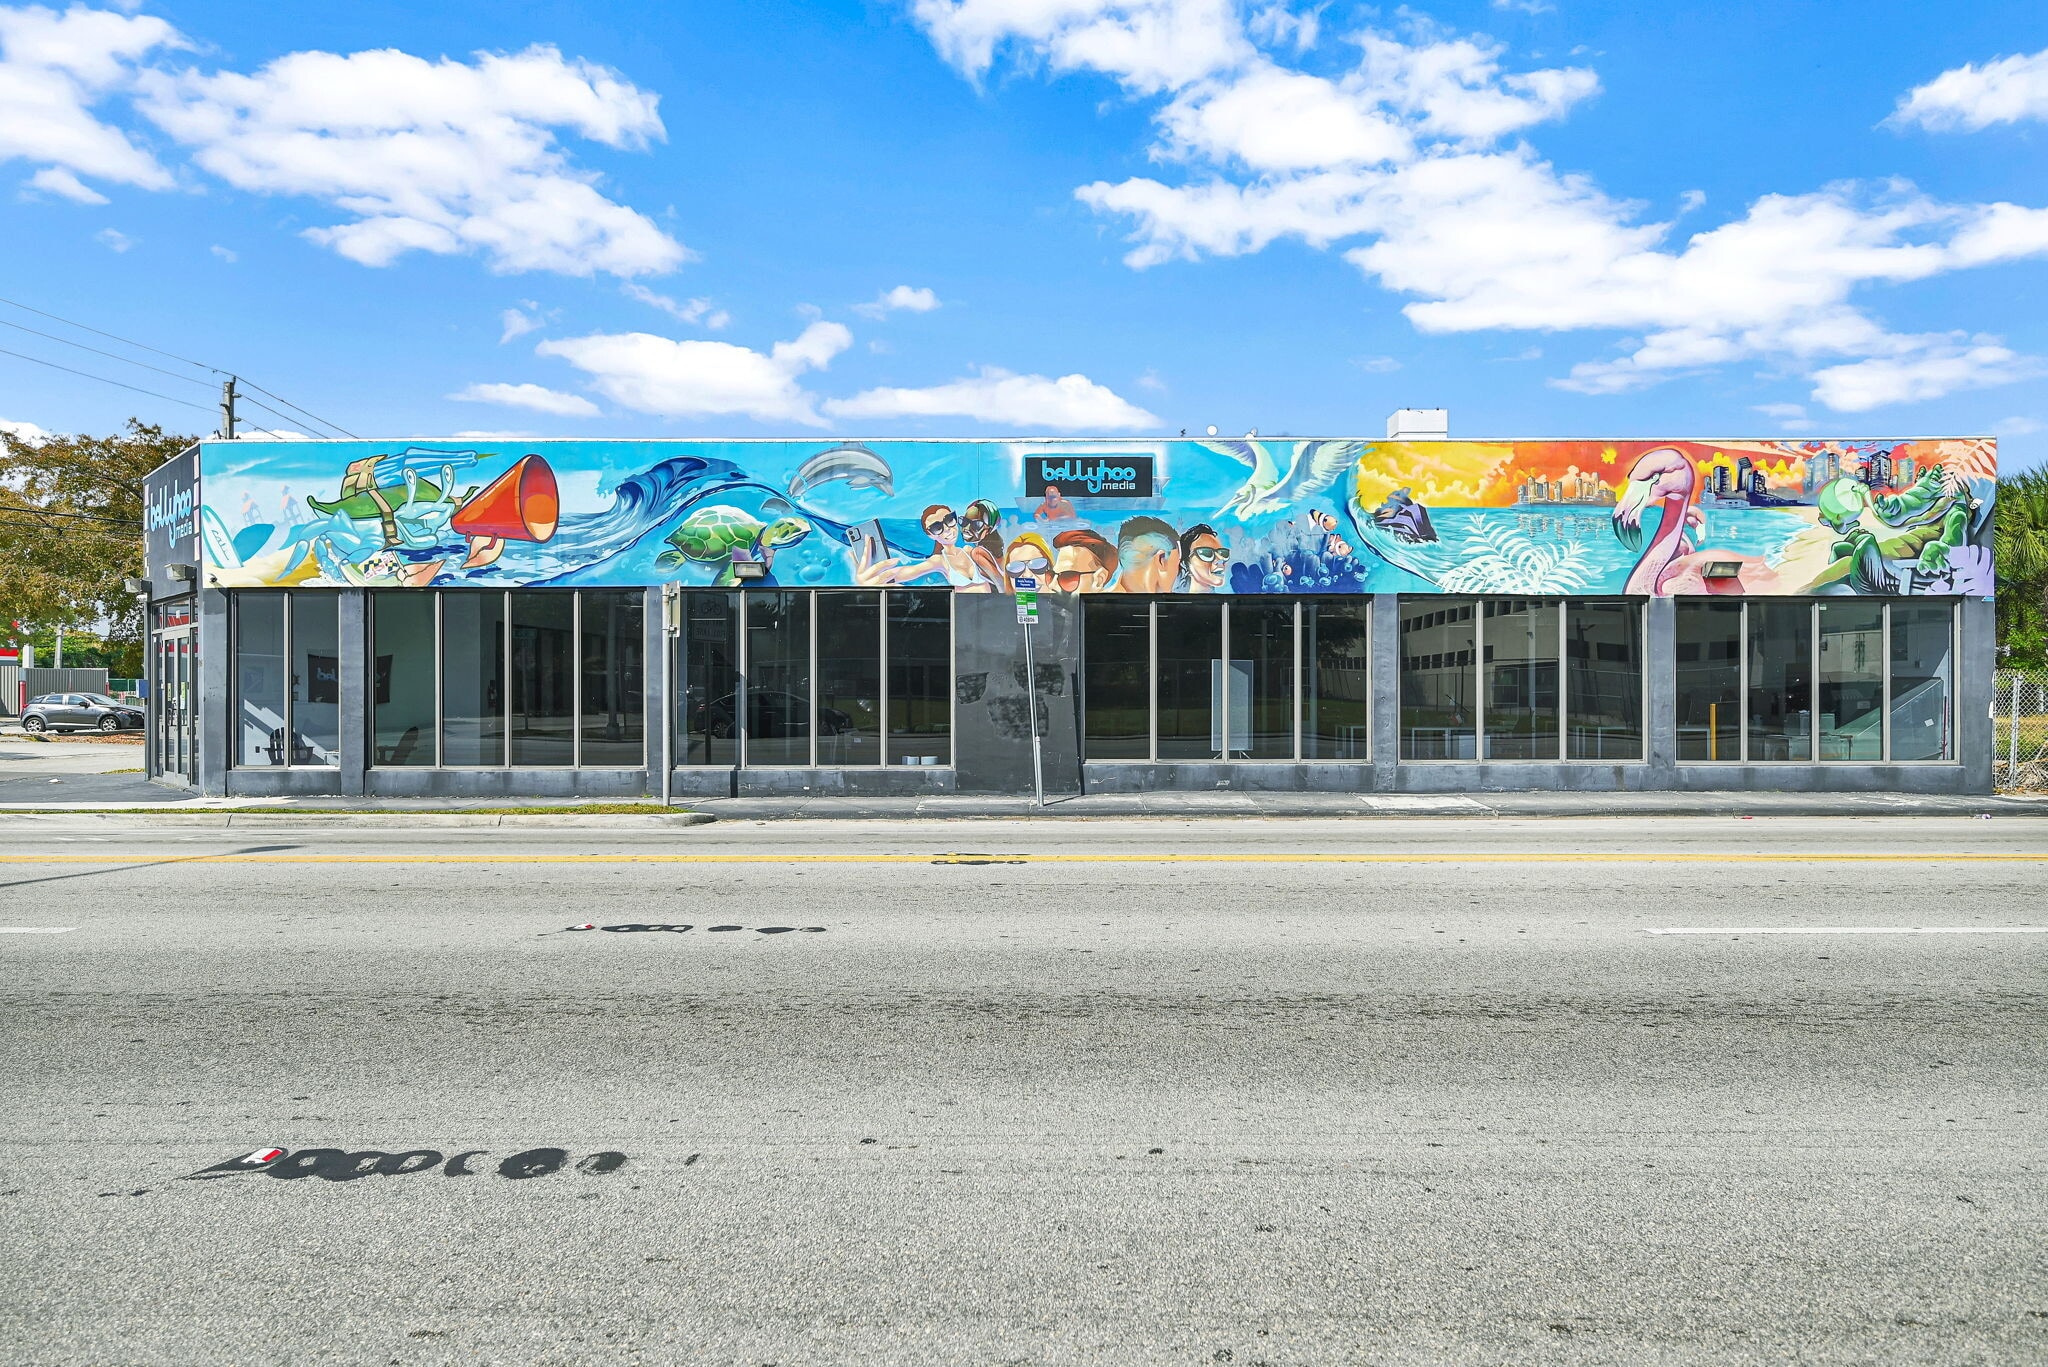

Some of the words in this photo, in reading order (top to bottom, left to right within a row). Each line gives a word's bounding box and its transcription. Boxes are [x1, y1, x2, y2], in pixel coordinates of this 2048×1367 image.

[1041, 459, 1137, 494] ballyhoo
[1101, 480, 1136, 490] media
[150, 479, 192, 549] ballyhoo
[175, 519, 193, 540] media
